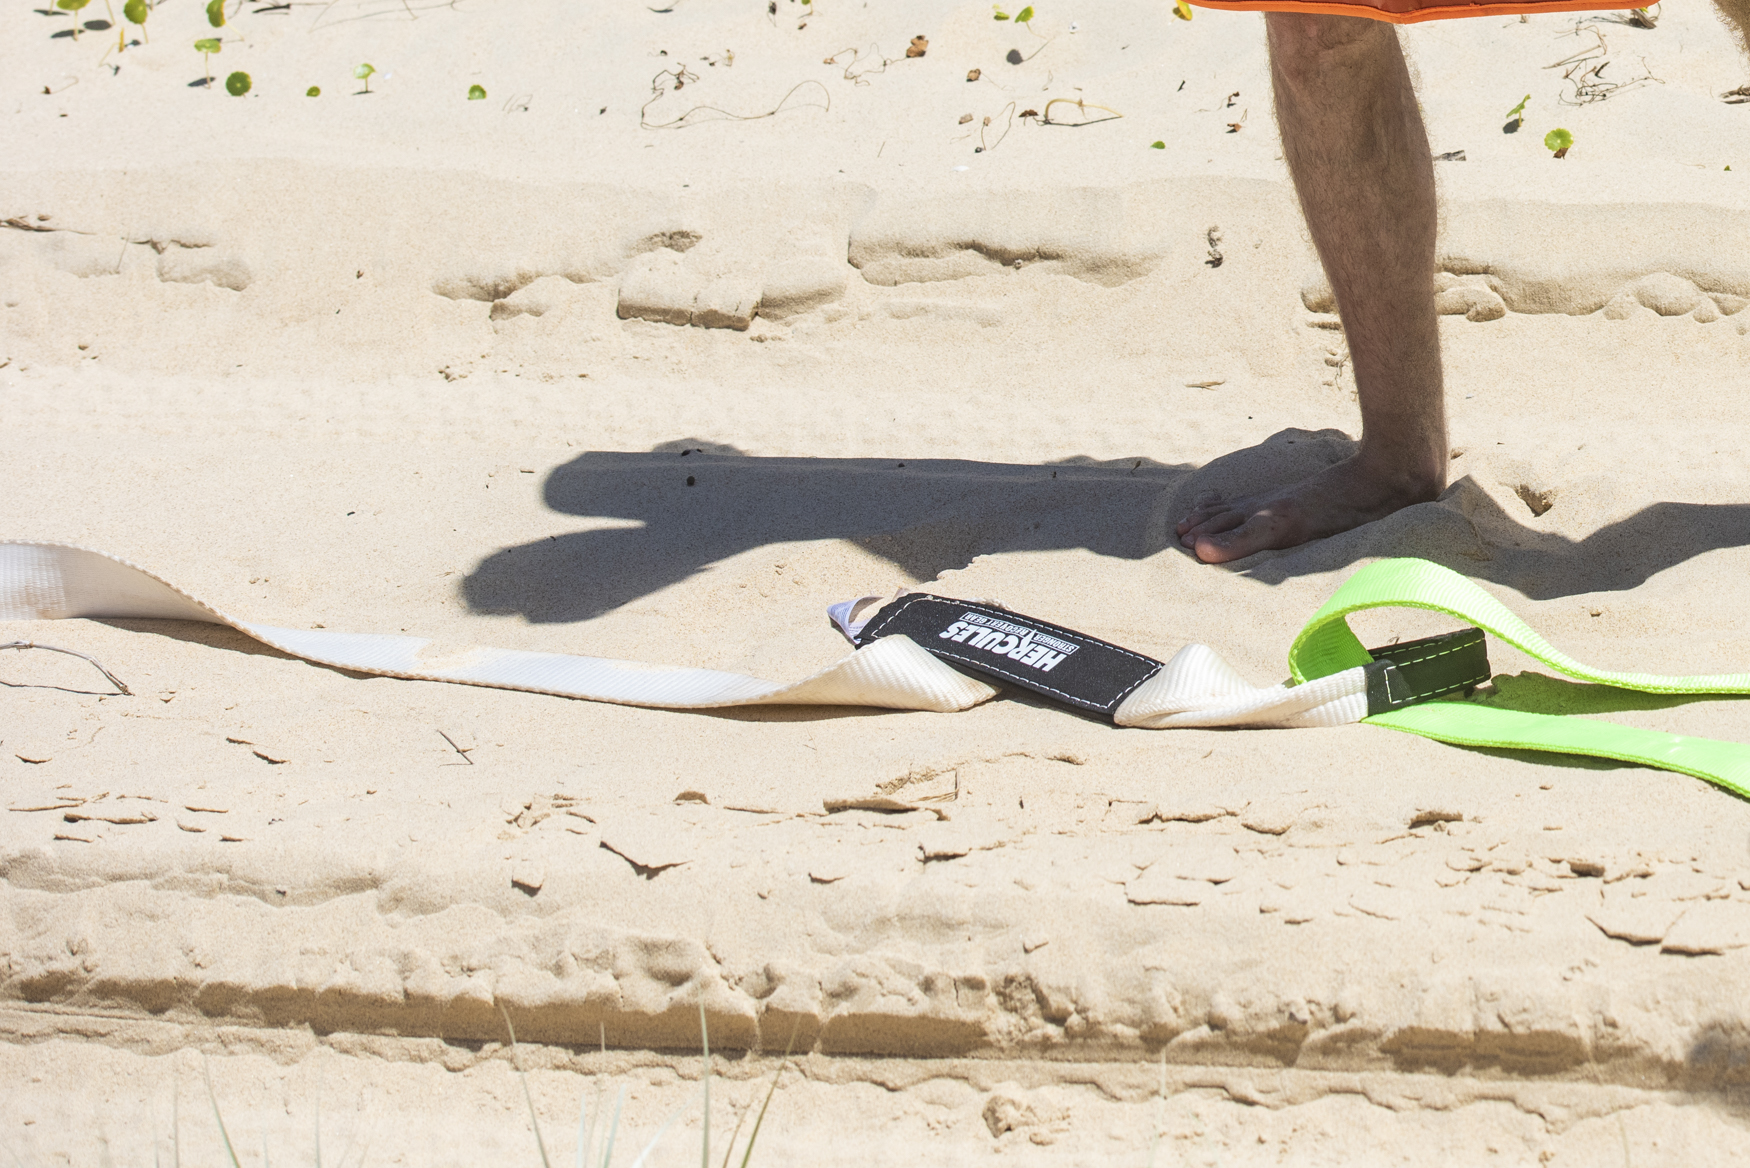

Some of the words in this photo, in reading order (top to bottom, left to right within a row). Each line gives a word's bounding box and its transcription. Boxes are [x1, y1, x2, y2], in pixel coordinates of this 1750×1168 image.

[965, 613, 984, 624] GEAR
[986, 619, 1030, 637] RECOVERY
[939, 621, 1067, 672] HERCULES
[1034, 632, 1076, 652] STRONGER
